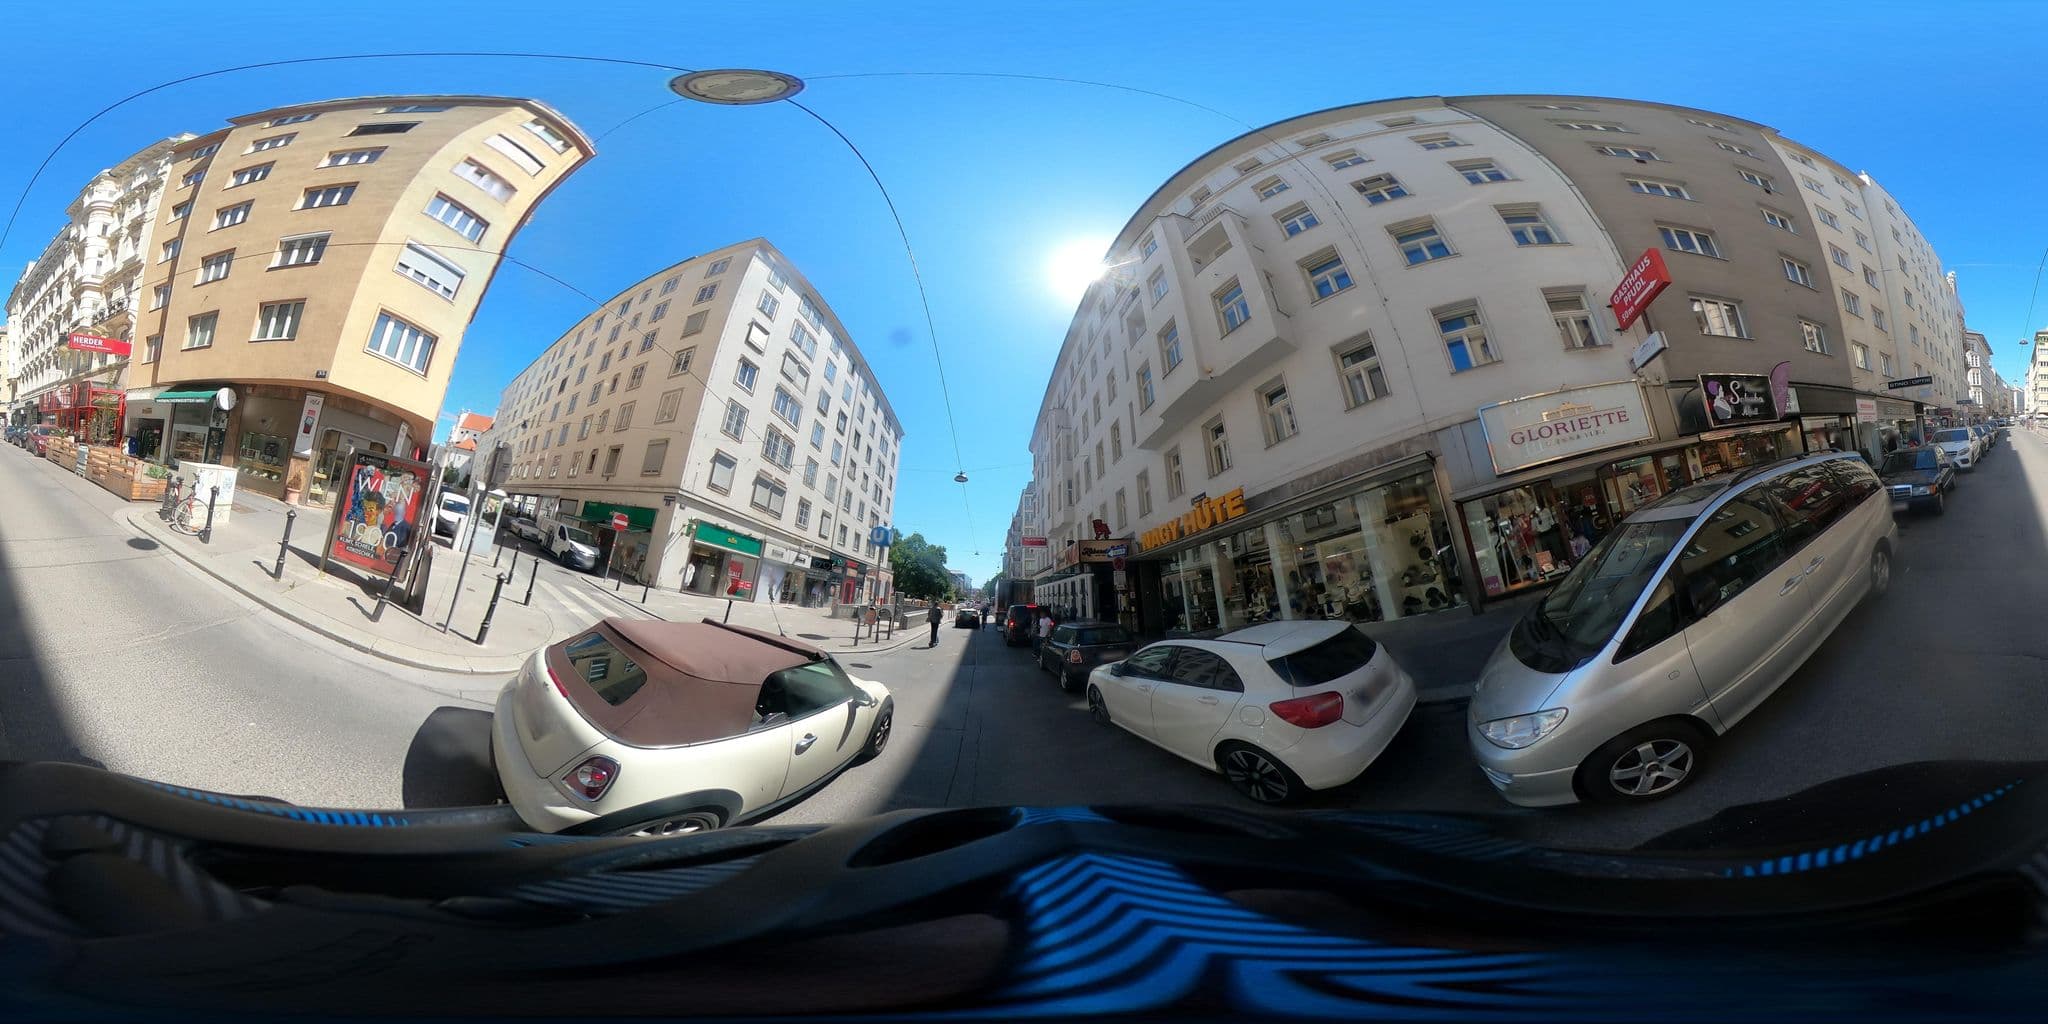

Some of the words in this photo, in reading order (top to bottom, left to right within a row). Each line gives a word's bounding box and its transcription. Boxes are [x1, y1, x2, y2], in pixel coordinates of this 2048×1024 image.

[1613, 256, 1651, 304] GASTHAUS
[1623, 278, 1646, 305] PFUDL
[73, 335, 104, 346] HERDER
[1510, 410, 1630, 446] GLORIETTE
[358, 474, 414, 506] WIEN
[1141, 516, 1181, 551] NAGY
[1182, 486, 1248, 537] HÜTE
[348, 520, 398, 550] 1900
[873, 529, 884, 543] U
